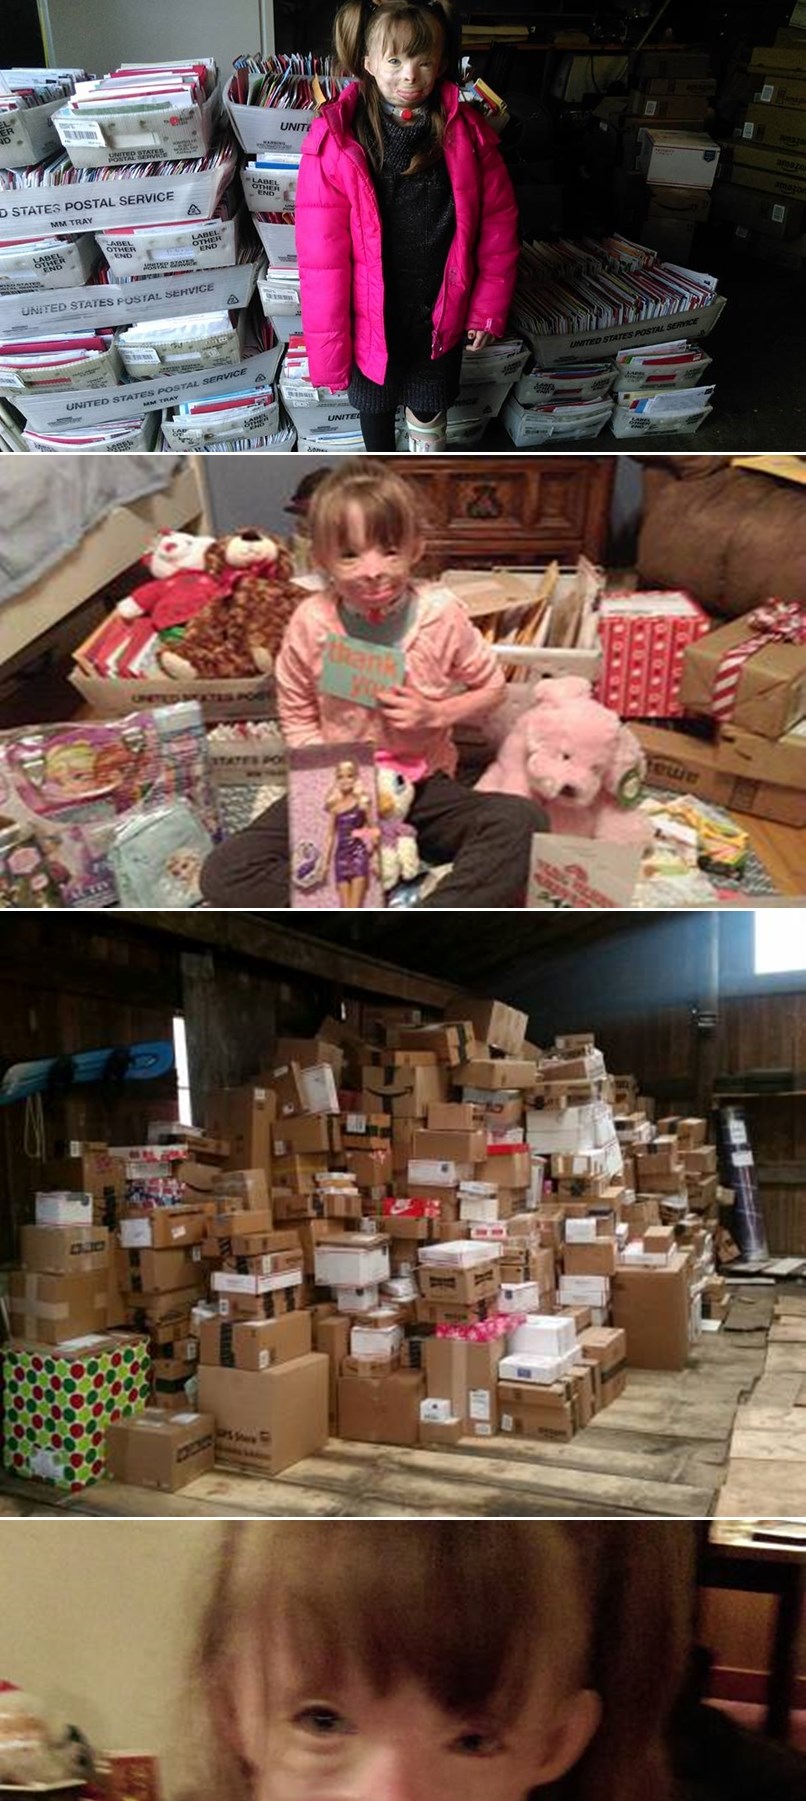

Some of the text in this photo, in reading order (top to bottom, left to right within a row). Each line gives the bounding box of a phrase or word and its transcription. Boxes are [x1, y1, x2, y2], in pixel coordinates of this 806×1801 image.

[252, 177, 279, 185] LABEL
[12, 204, 61, 217] STATES
[64, 196, 116, 212] POSTAL
[119, 191, 175, 206] SERVICE
[50, 217, 94, 229] MM TRAY
[191, 229, 219, 241] LABEL
[192, 235, 222, 247] OTHER
[199, 243, 218, 252] END
[33, 252, 63, 264] LABEL
[34, 258, 66, 270] OTHER
[43, 264, 63, 273] END
[21, 283, 215, 316] UNITED STATES POSTAL SERVICE
[570, 317, 699, 349] UNITED STATES POSTAL SERVICE
[66, 368, 248, 411] UNITED STATES POSTAL SERVICE
[143, 396, 179, 407] MM TRAY
[328, 641, 397, 678] thank
